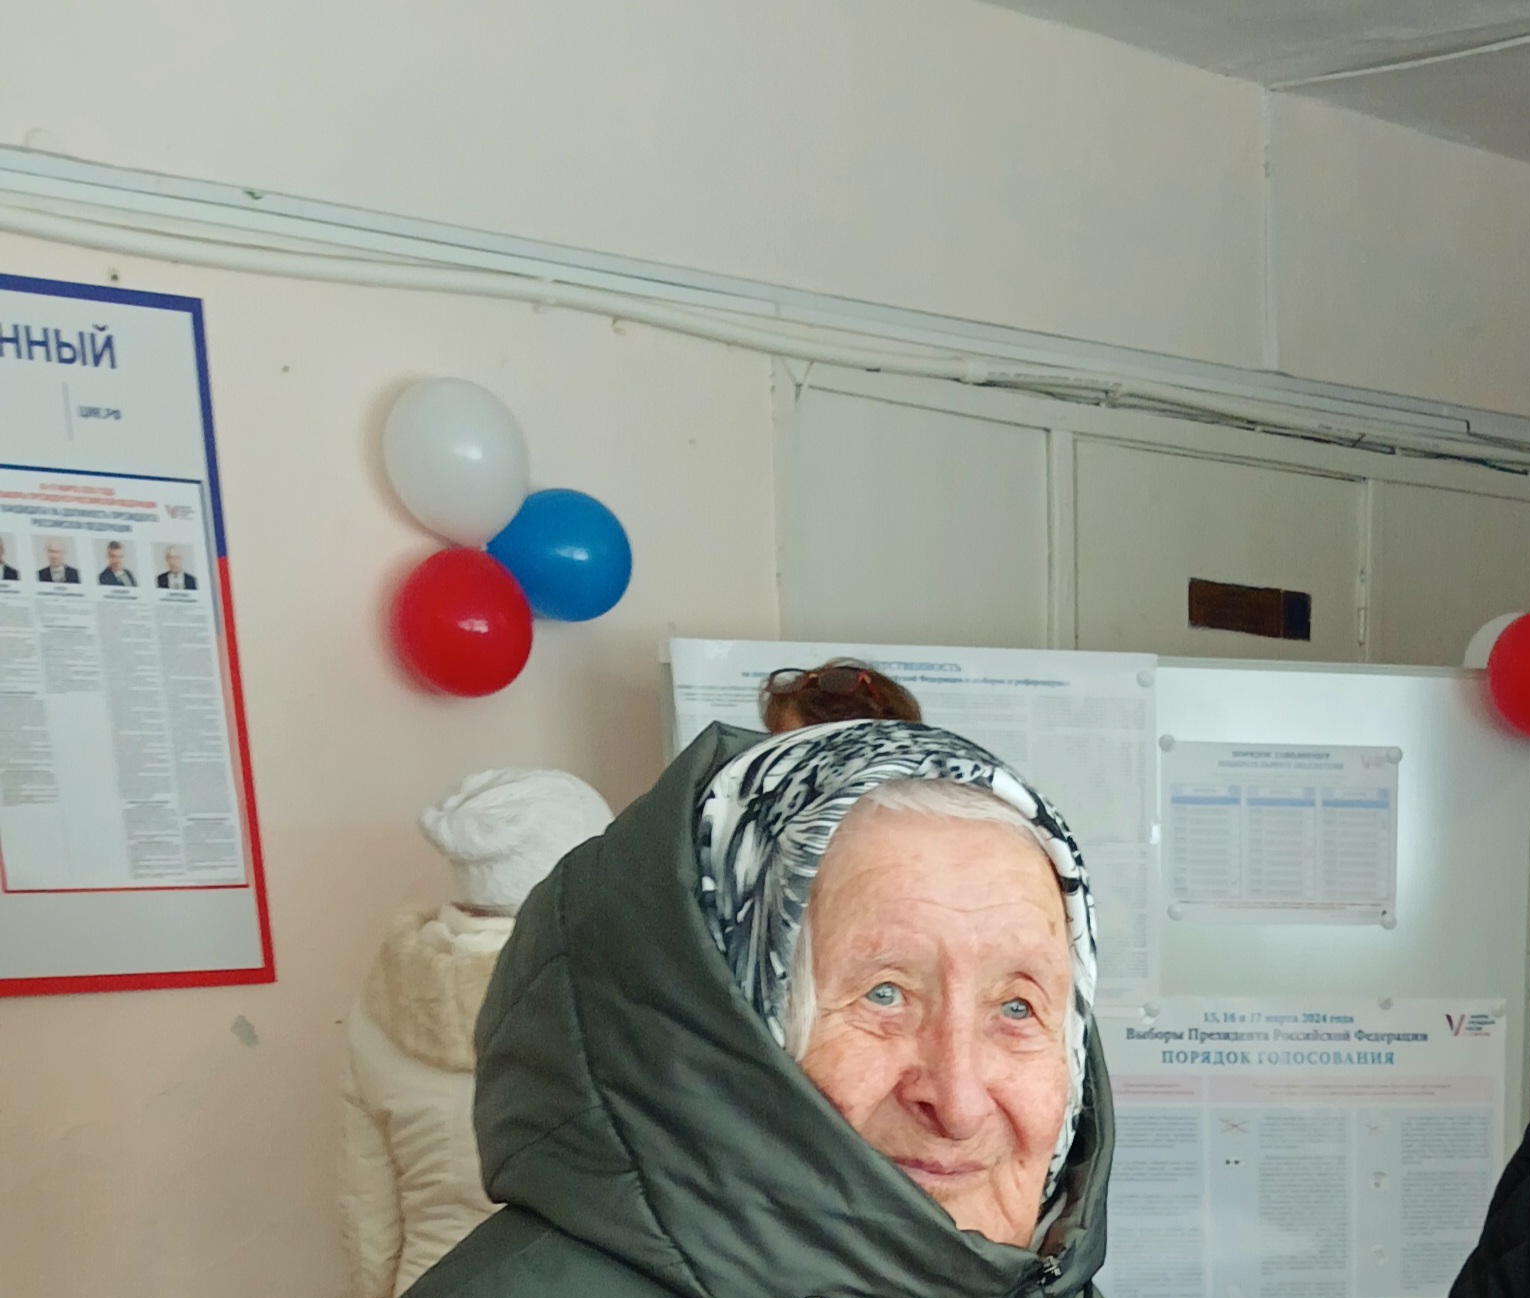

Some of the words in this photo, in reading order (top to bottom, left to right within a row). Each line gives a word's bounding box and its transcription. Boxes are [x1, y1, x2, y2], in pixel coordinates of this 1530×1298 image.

[0, 323, 117, 369] ННЫЙ
[1301, 1013, 1327, 1024] 2024
[1126, 1028, 1184, 1043] Выборы
[1187, 1028, 1270, 1044] Президента
[1354, 1029, 1429, 1045] Федерации
[1161, 1050, 1250, 1065] ПОРЯДОК
[1256, 1051, 1396, 1066] ГОЛОСОВАНИЯ
